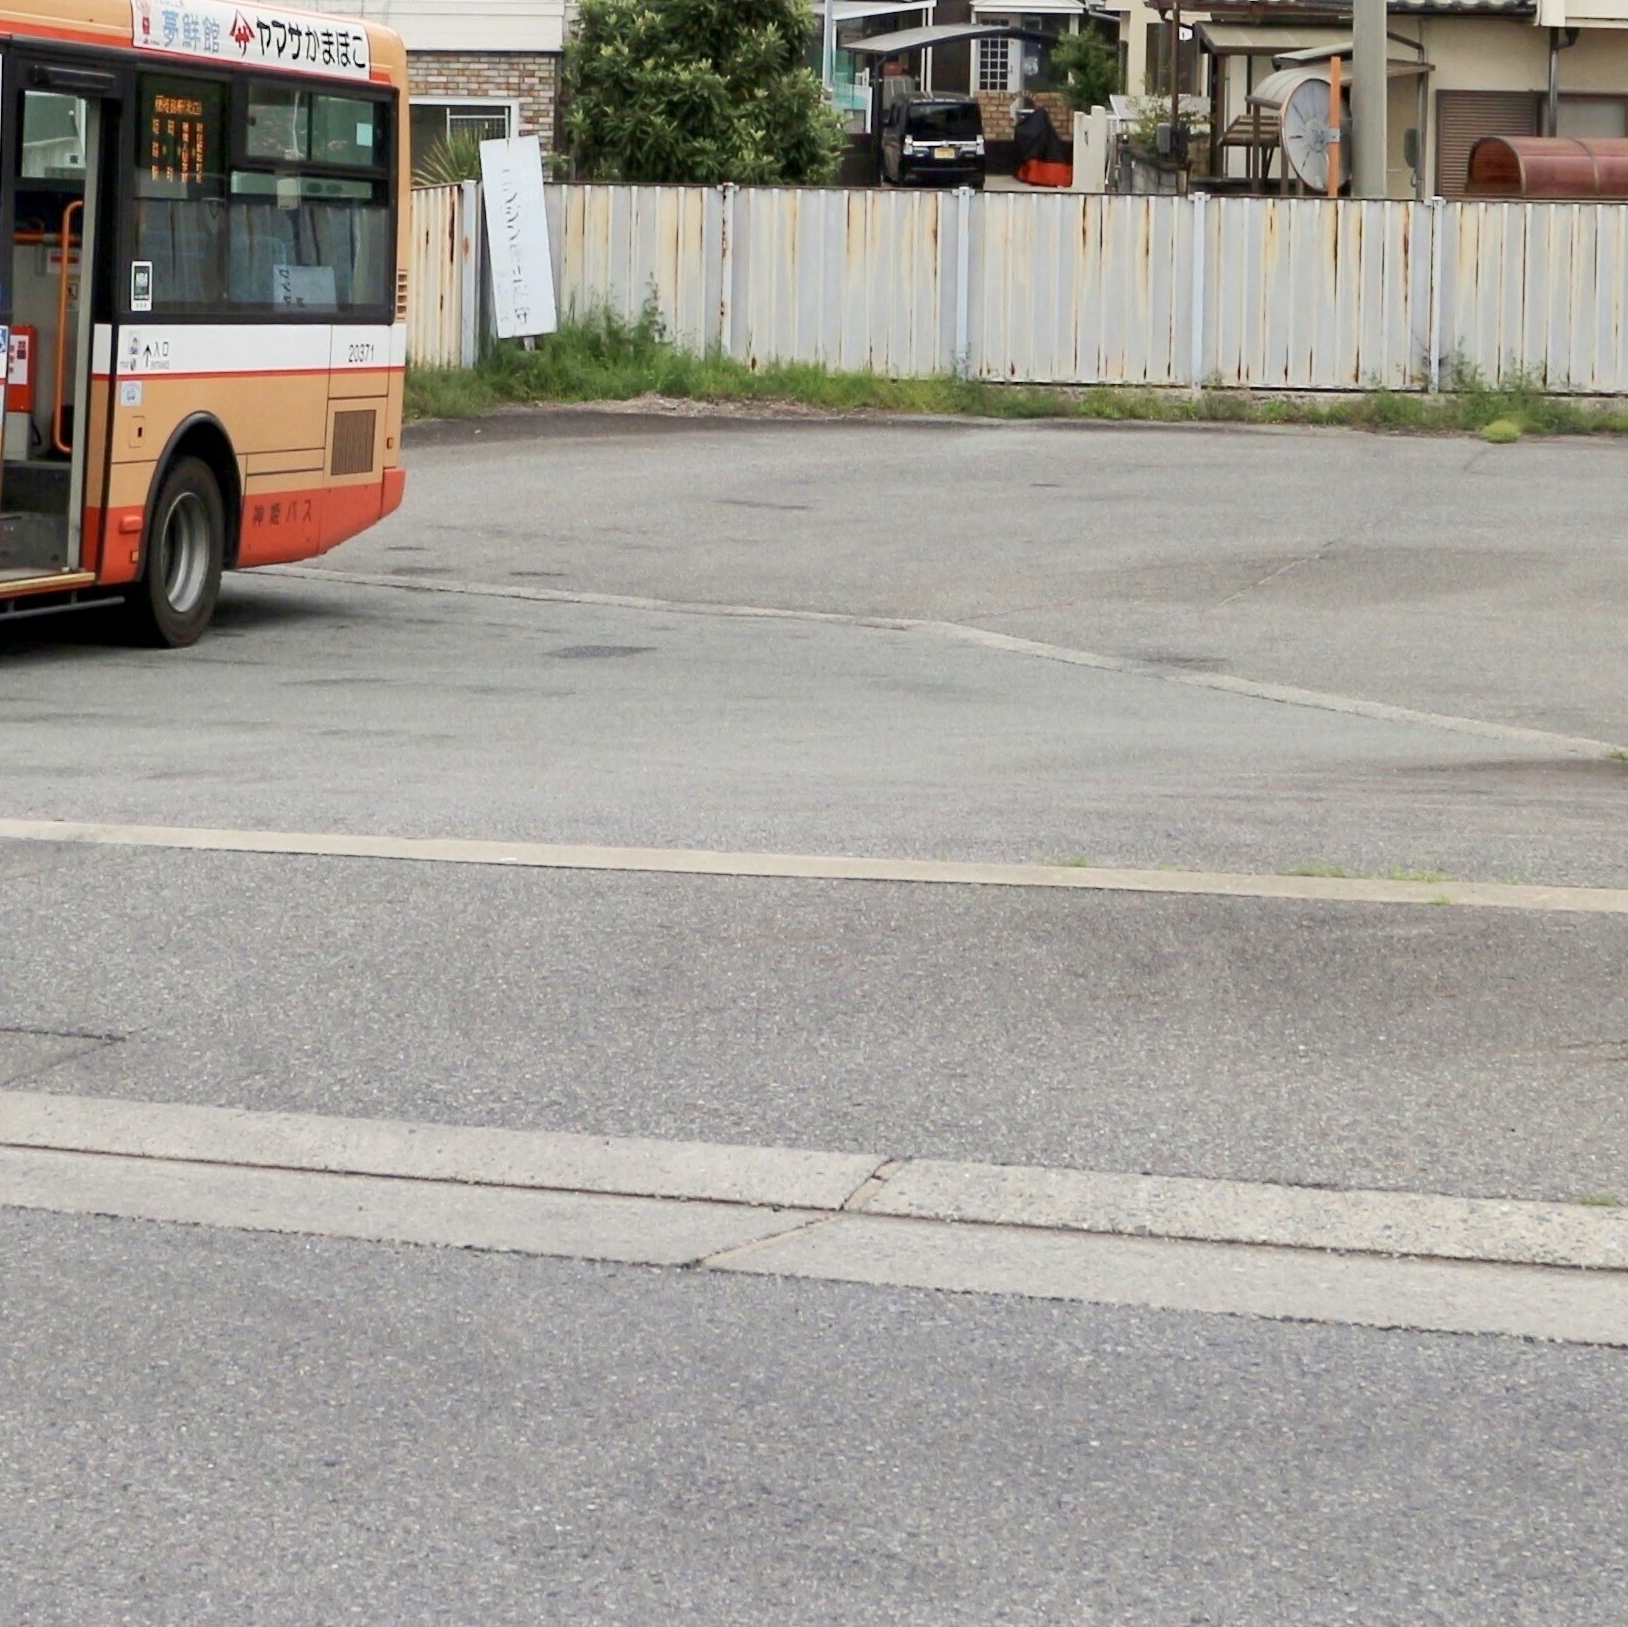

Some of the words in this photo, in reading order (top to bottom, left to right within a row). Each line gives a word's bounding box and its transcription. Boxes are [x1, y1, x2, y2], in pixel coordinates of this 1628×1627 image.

[161, 9, 220, 54] 夢鮮館
[256, 16, 366, 69] ヤマサかまぼこ
[153, 341, 169, 358] 入口
[348, 343, 375, 363] 20371
[253, 500, 312, 526] 神姫バス
